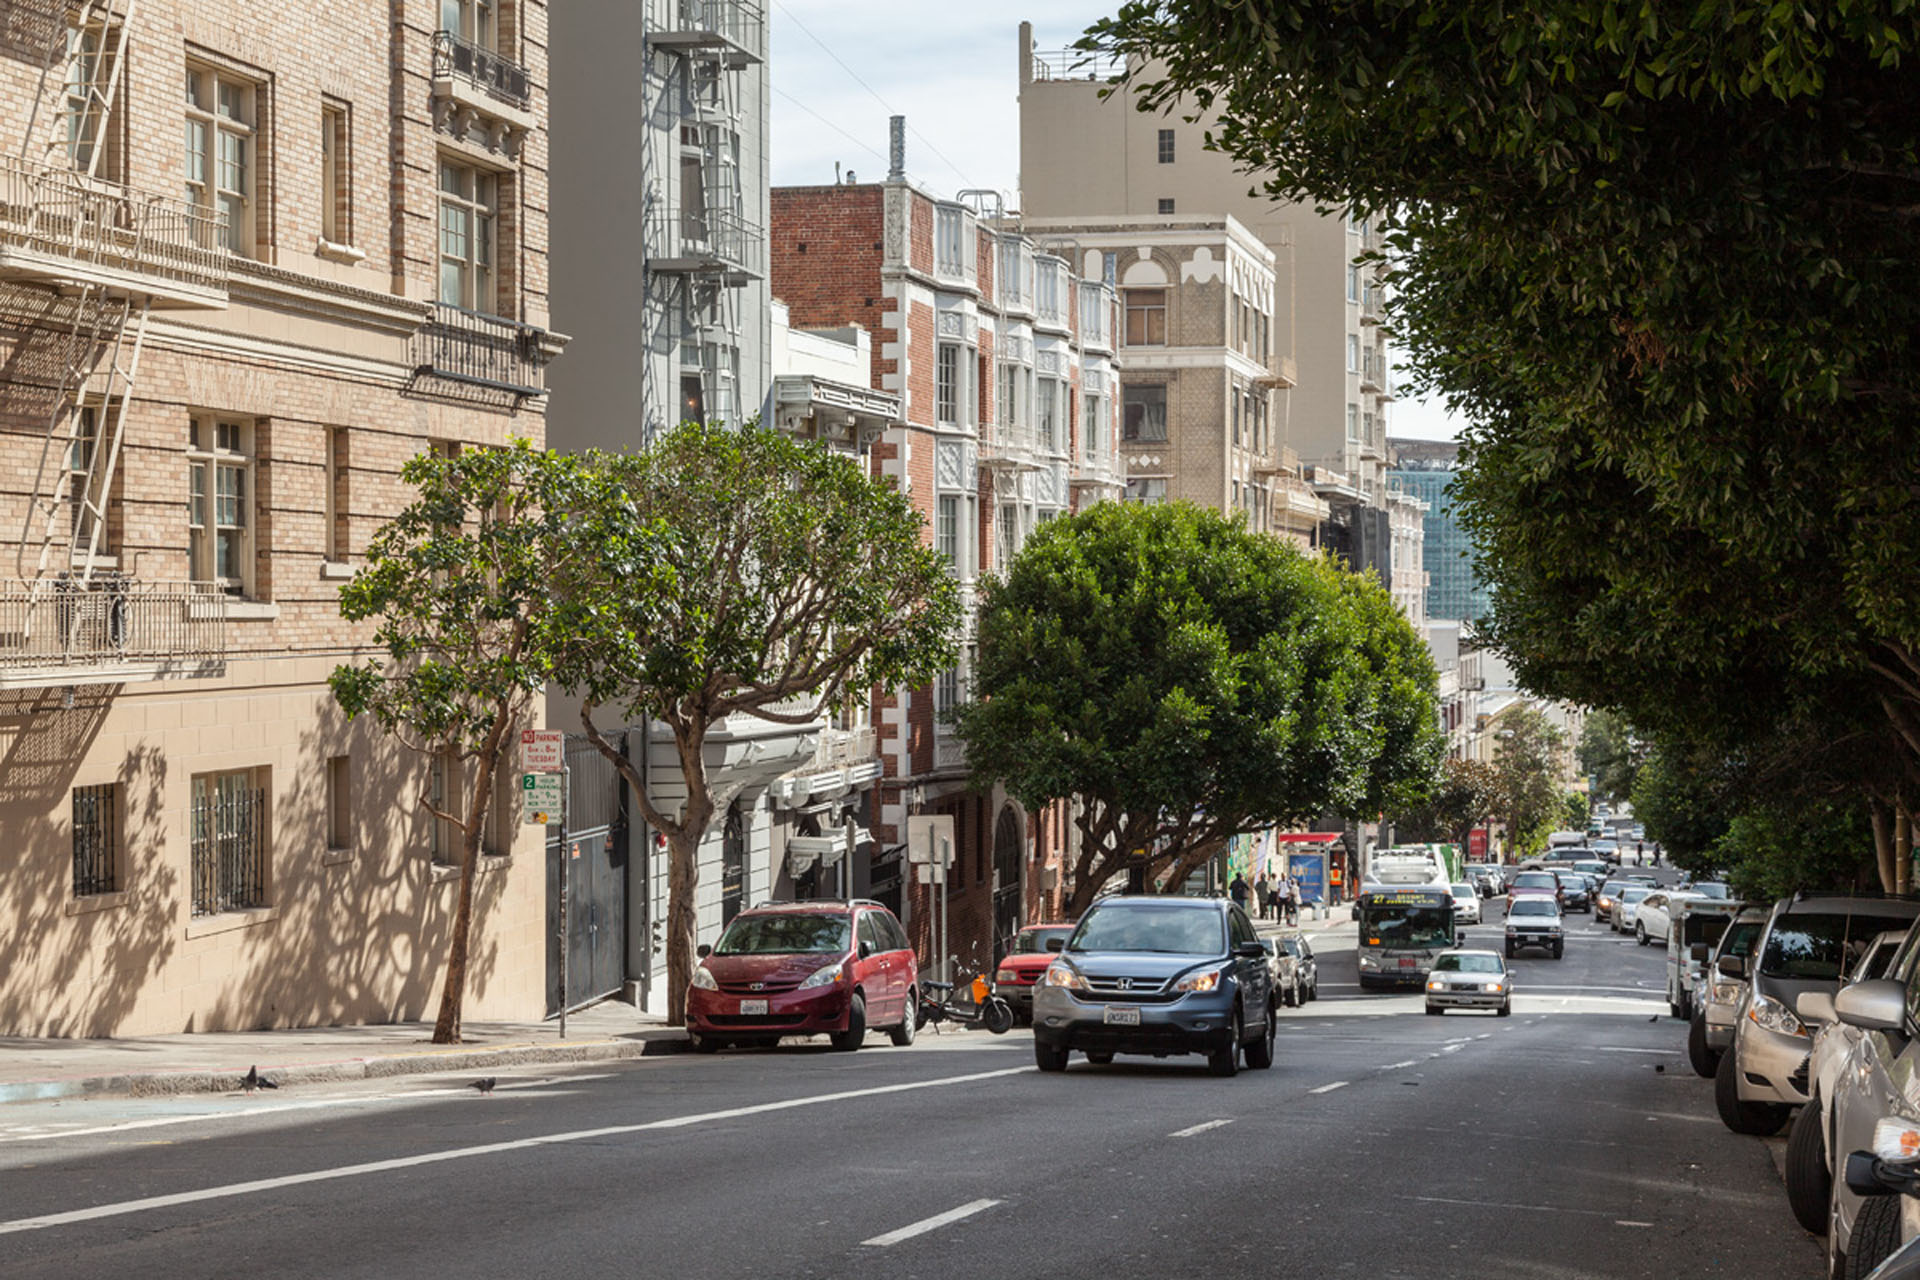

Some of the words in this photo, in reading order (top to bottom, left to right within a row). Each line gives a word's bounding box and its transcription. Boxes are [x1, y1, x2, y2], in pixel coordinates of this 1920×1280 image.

[523, 732, 534, 742] NO
[536, 734, 561, 742] PARKING
[526, 777, 533, 788] 2
[1373, 894, 1385, 904] 27
